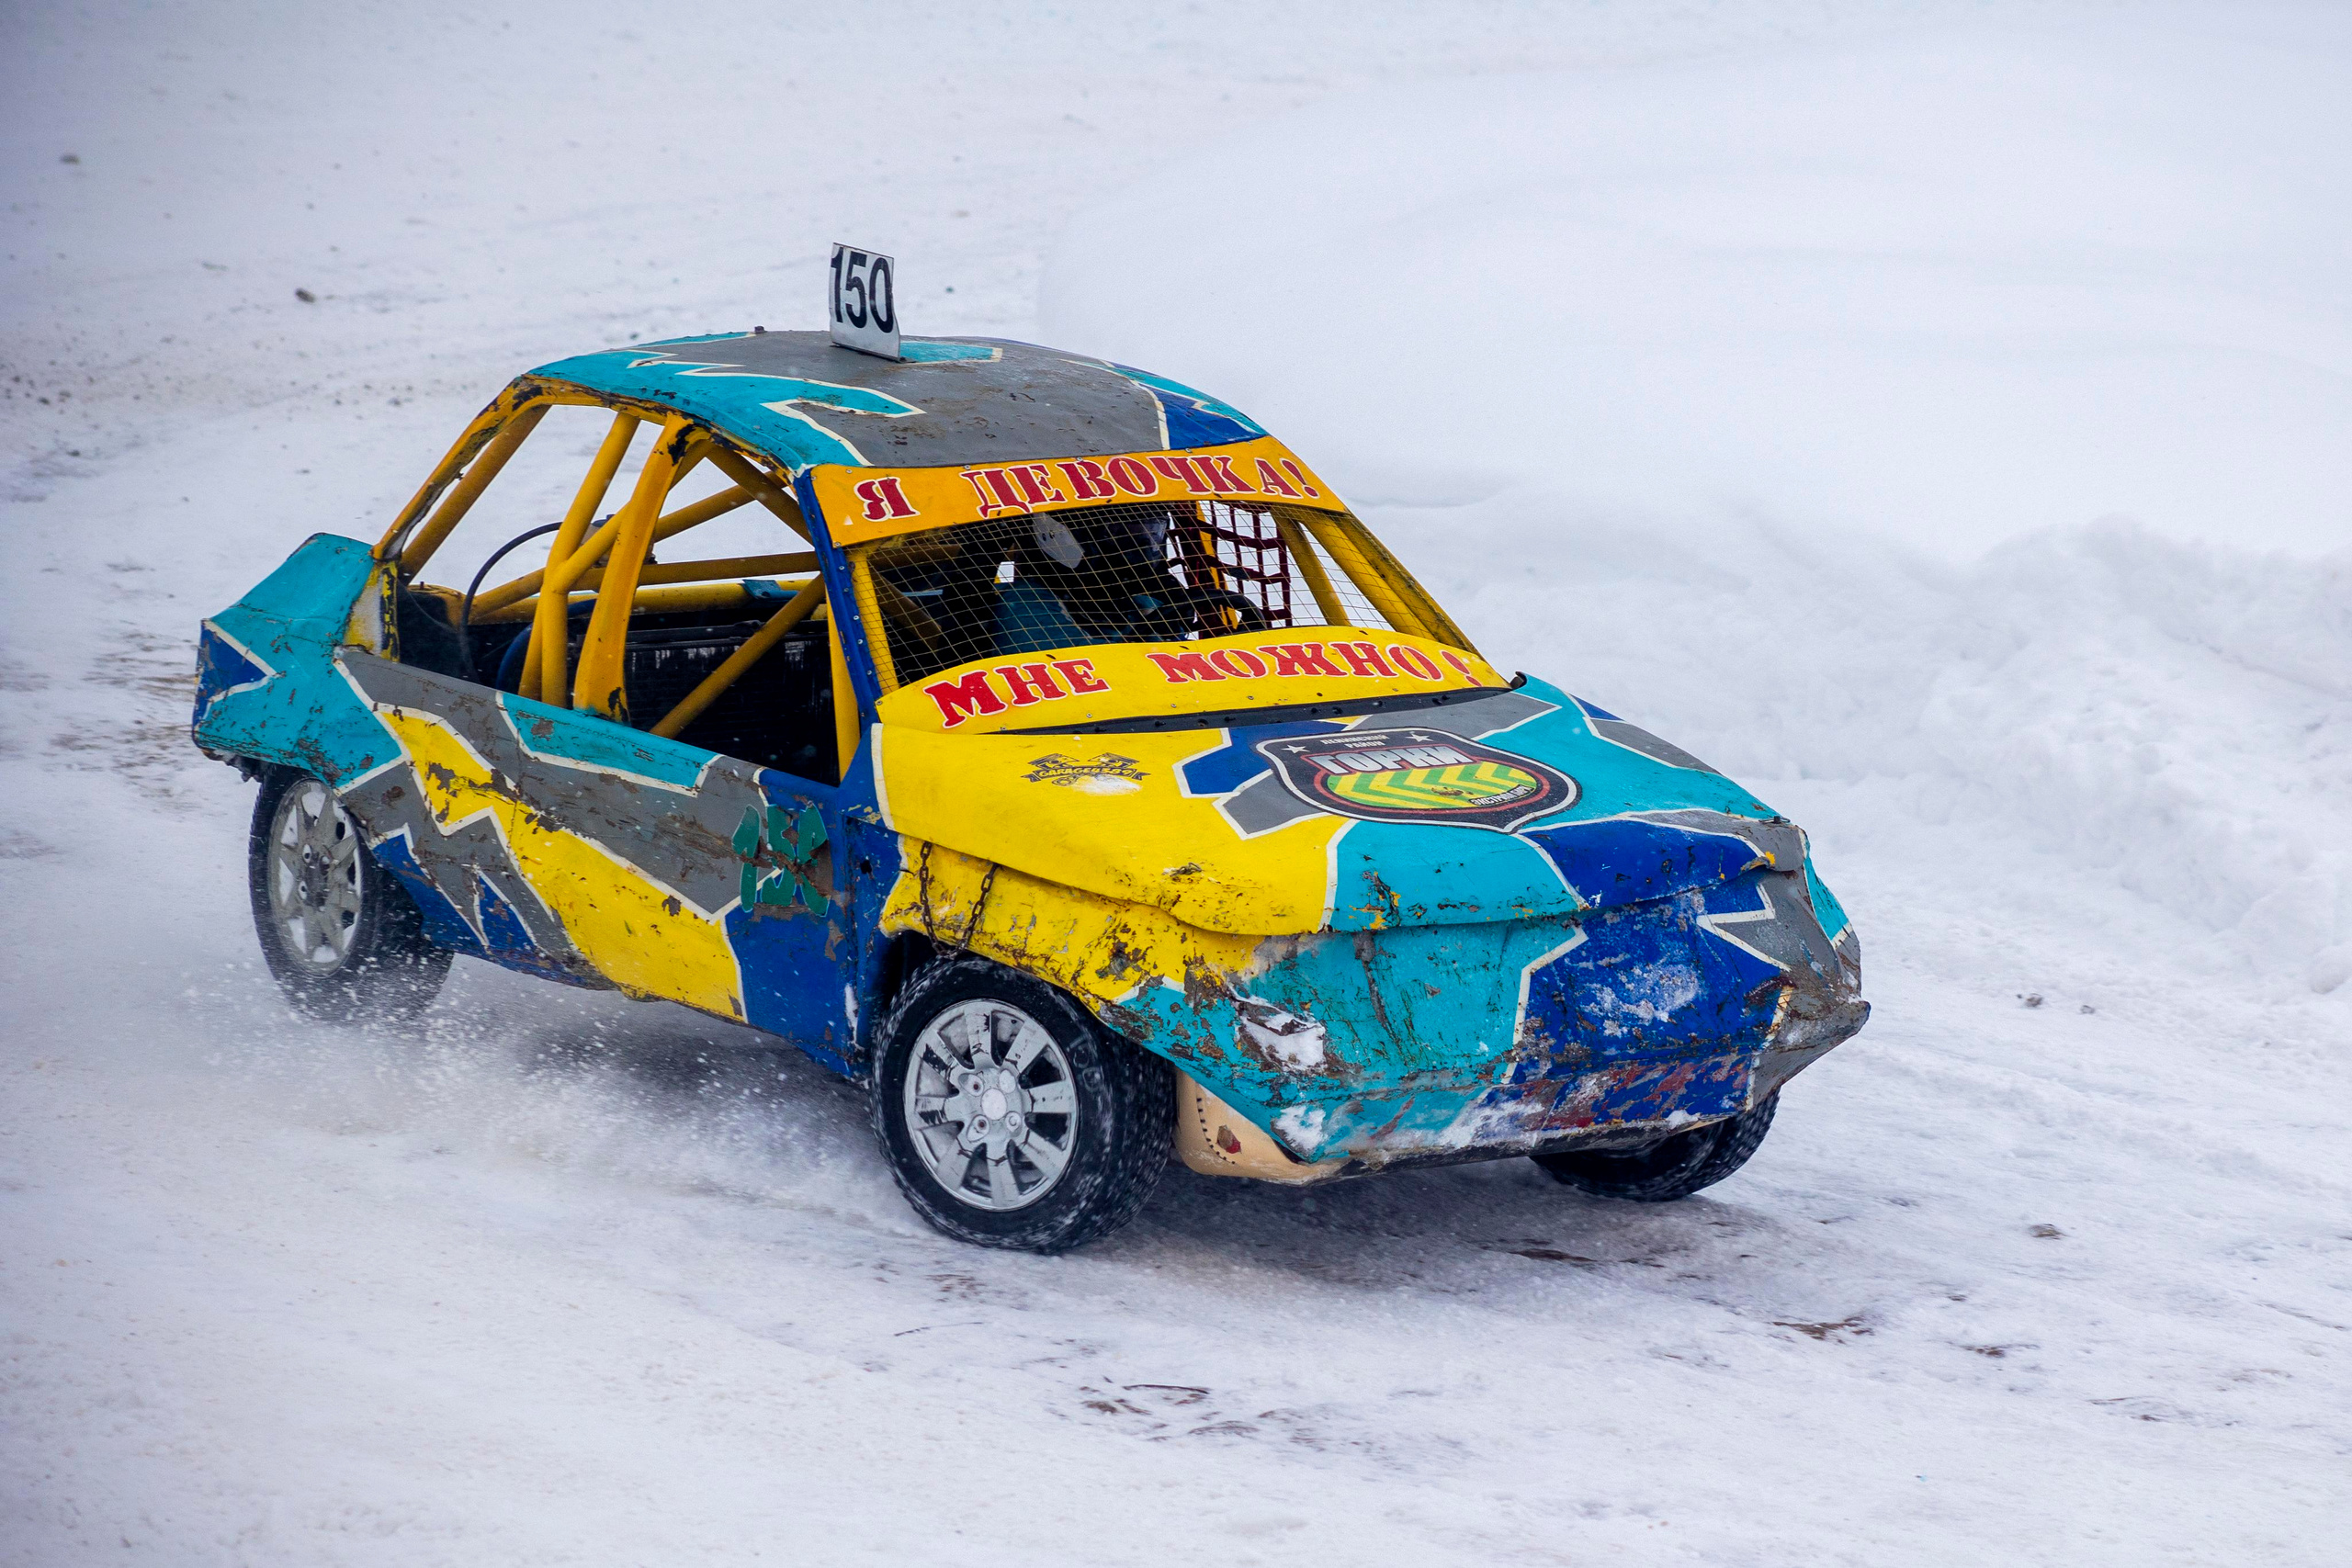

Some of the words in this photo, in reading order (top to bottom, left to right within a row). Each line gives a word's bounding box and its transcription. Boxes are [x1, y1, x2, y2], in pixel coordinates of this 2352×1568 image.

[831, 246, 894, 333] 150
[854, 478, 920, 522] Я
[961, 455, 1319, 519] ДЕВОЧКА!
[923, 659, 1112, 728] МНЕ
[1308, 746, 1474, 774] ГОРКИ
